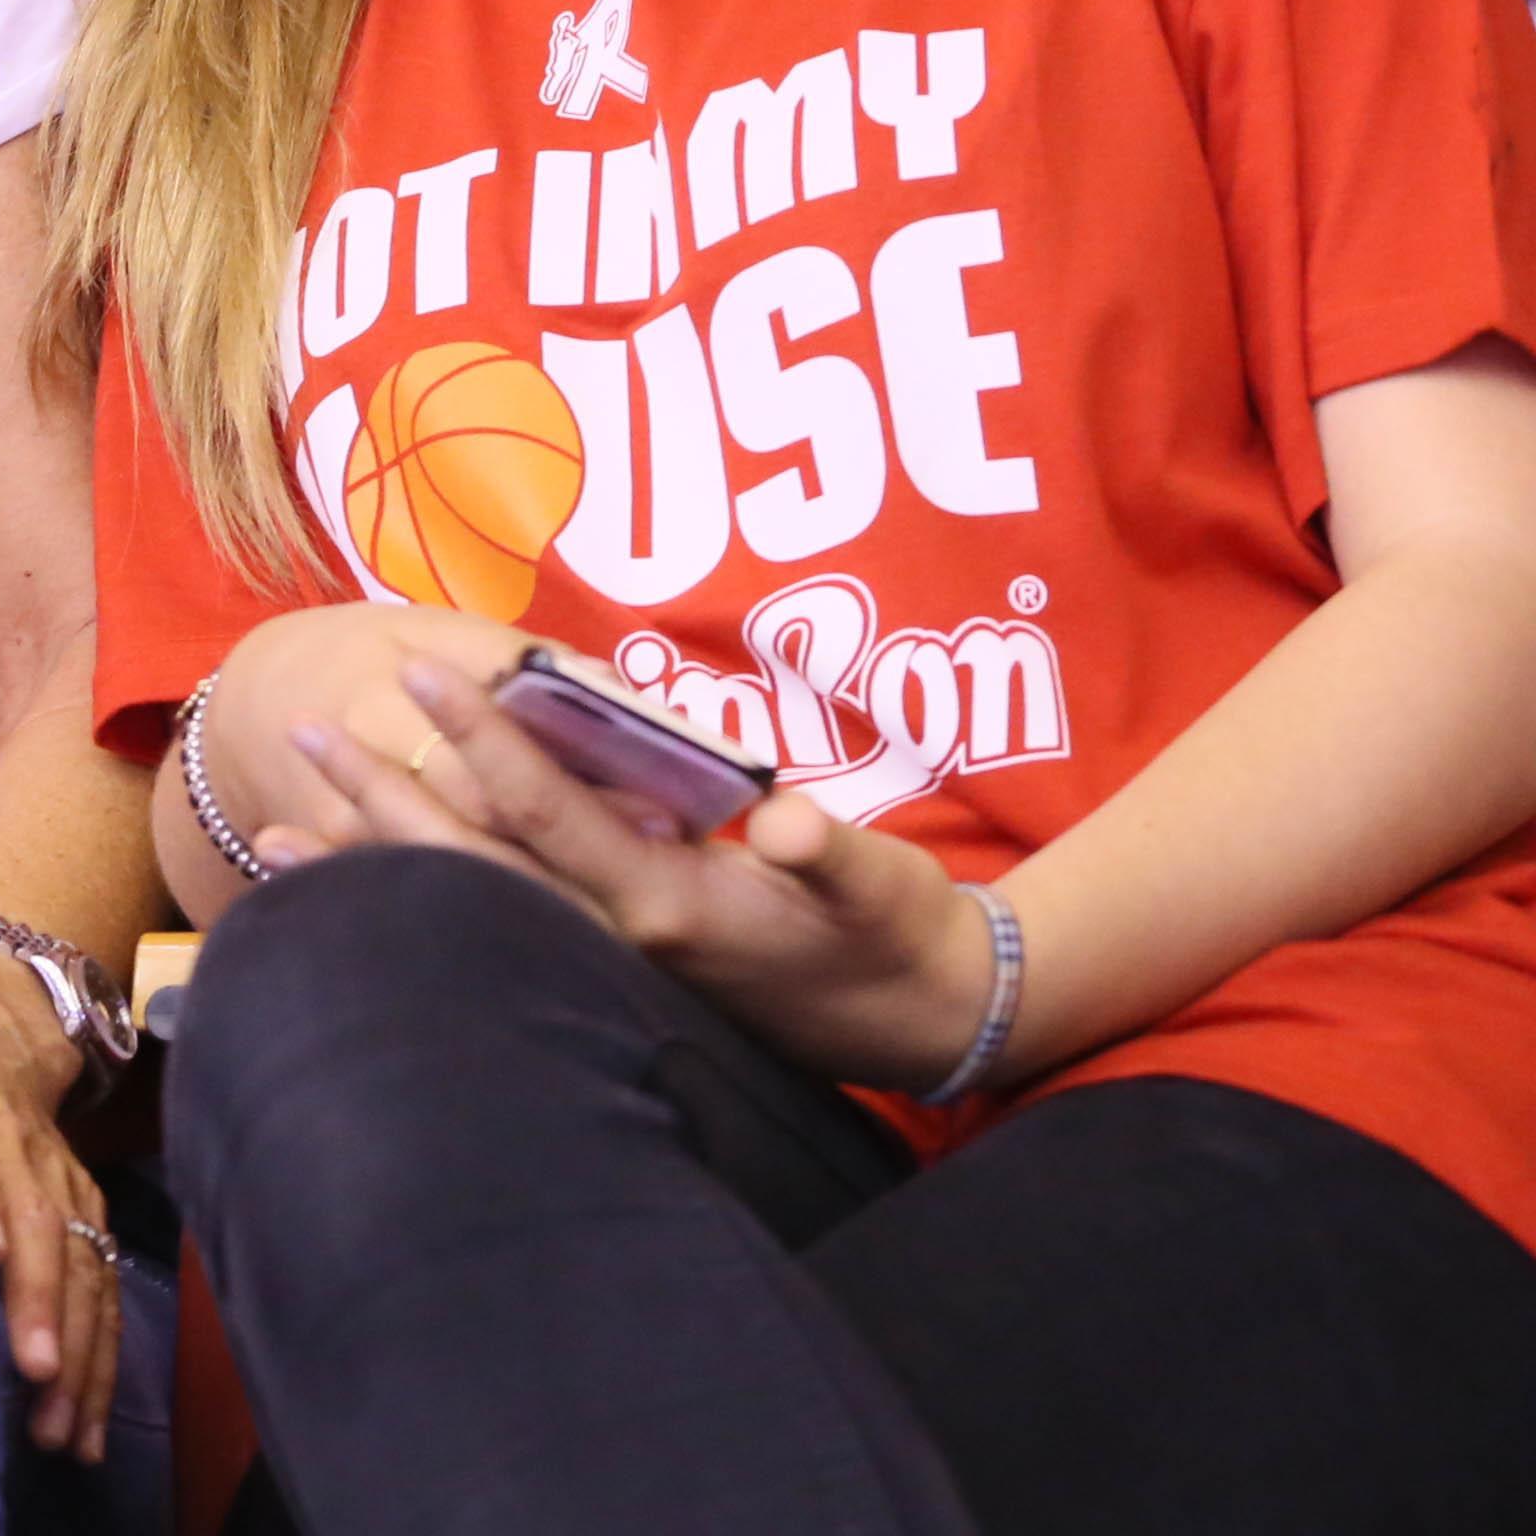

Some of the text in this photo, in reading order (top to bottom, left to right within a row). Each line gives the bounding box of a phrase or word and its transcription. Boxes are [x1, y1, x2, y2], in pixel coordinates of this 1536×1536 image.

[280, 28, 986, 399] OT IN MY
